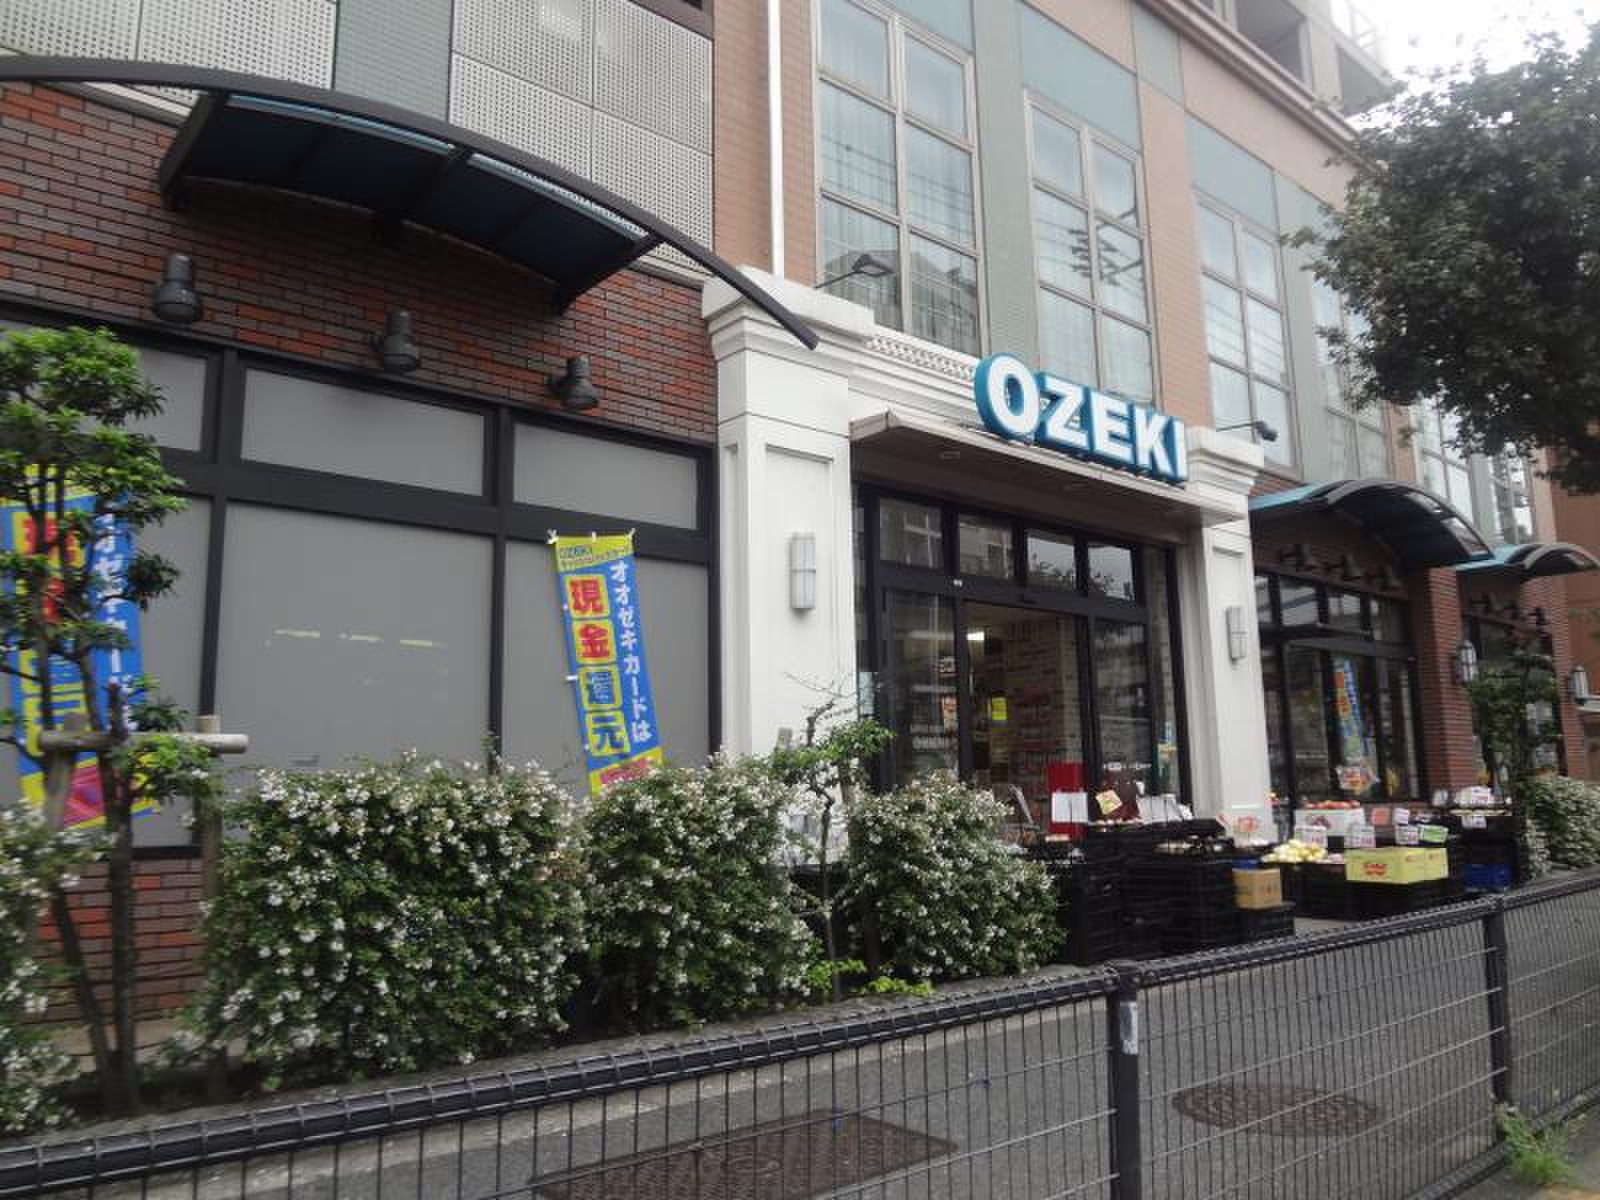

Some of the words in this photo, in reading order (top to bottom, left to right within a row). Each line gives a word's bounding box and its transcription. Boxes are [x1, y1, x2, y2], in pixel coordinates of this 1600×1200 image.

[976, 353, 1187, 481] OZEKI
[610, 560, 652, 744] オオゼキカードは
